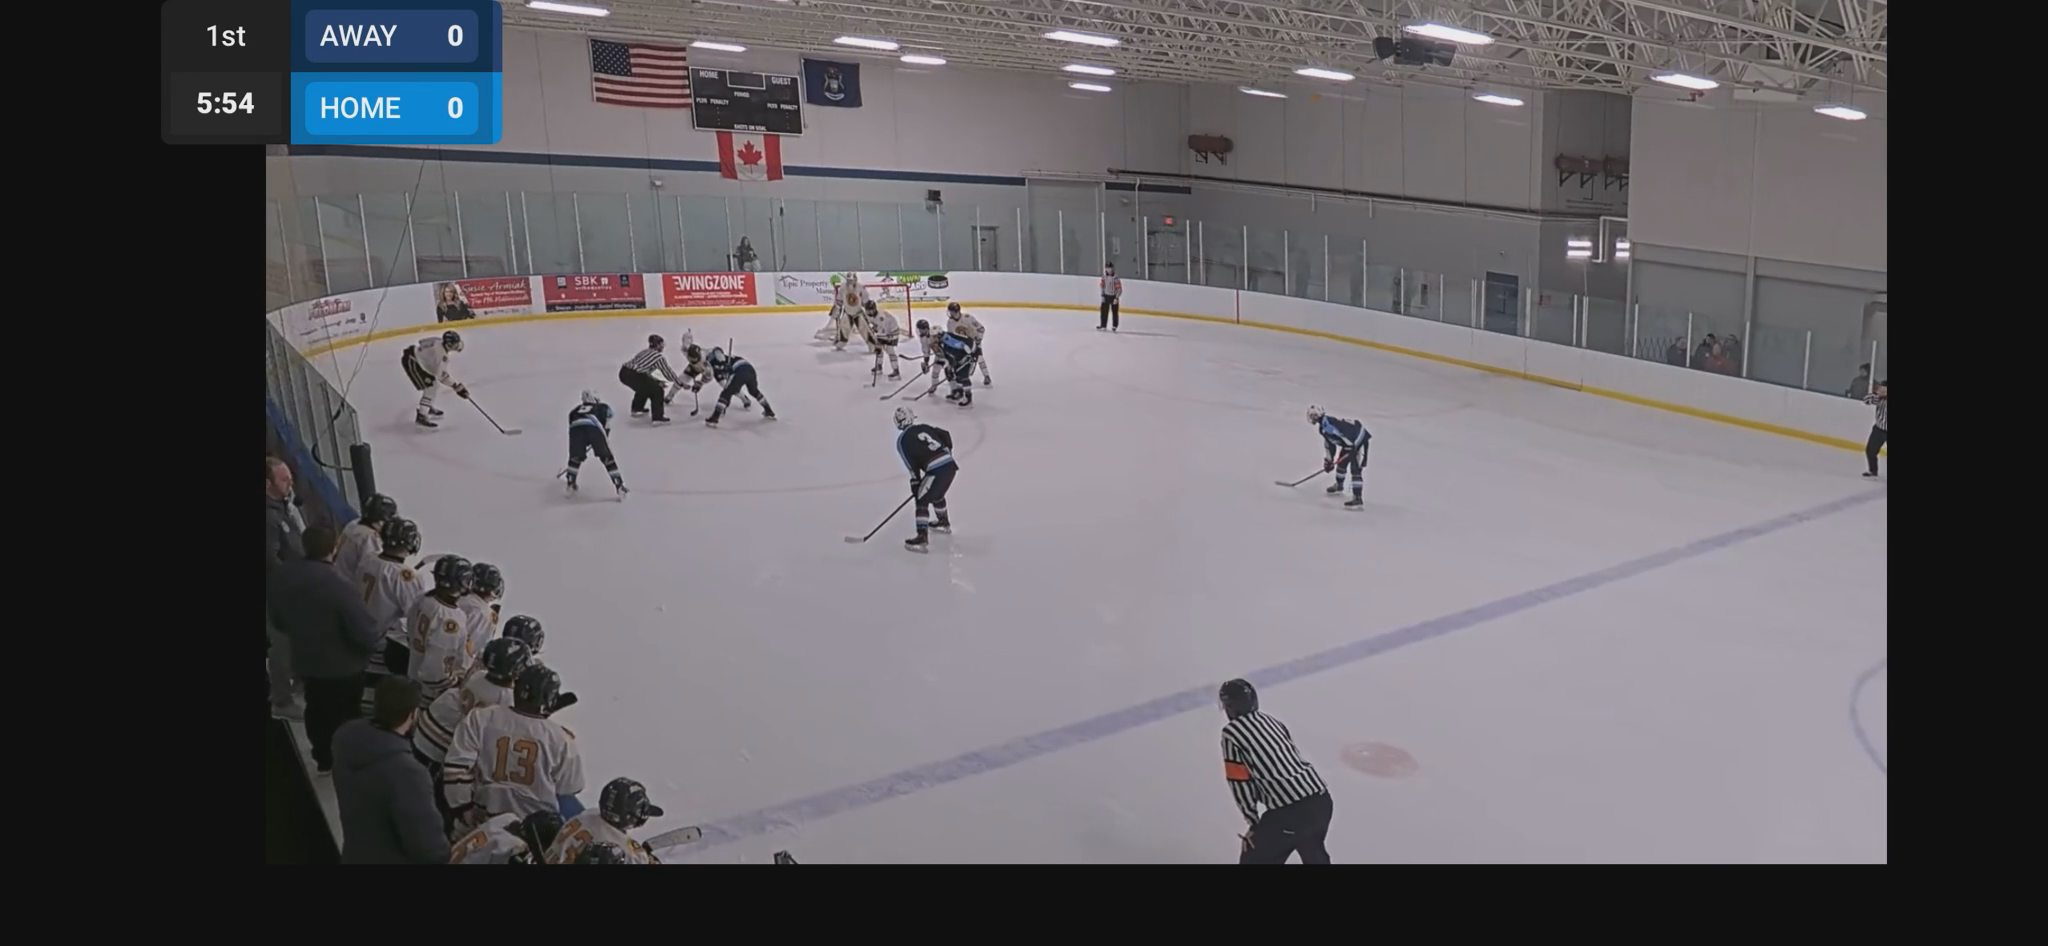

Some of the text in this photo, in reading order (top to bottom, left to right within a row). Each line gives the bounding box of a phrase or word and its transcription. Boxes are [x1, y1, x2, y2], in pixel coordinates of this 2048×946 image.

[699, 70, 719, 79] HOME
[771, 76, 791, 85] GUEST
[574, 275, 598, 286] SBK
[783, 279, 828, 289] Epic Property
[461, 283, 486, 294] Susie
[917, 431, 941, 451] 3
[491, 736, 539, 786] 13
